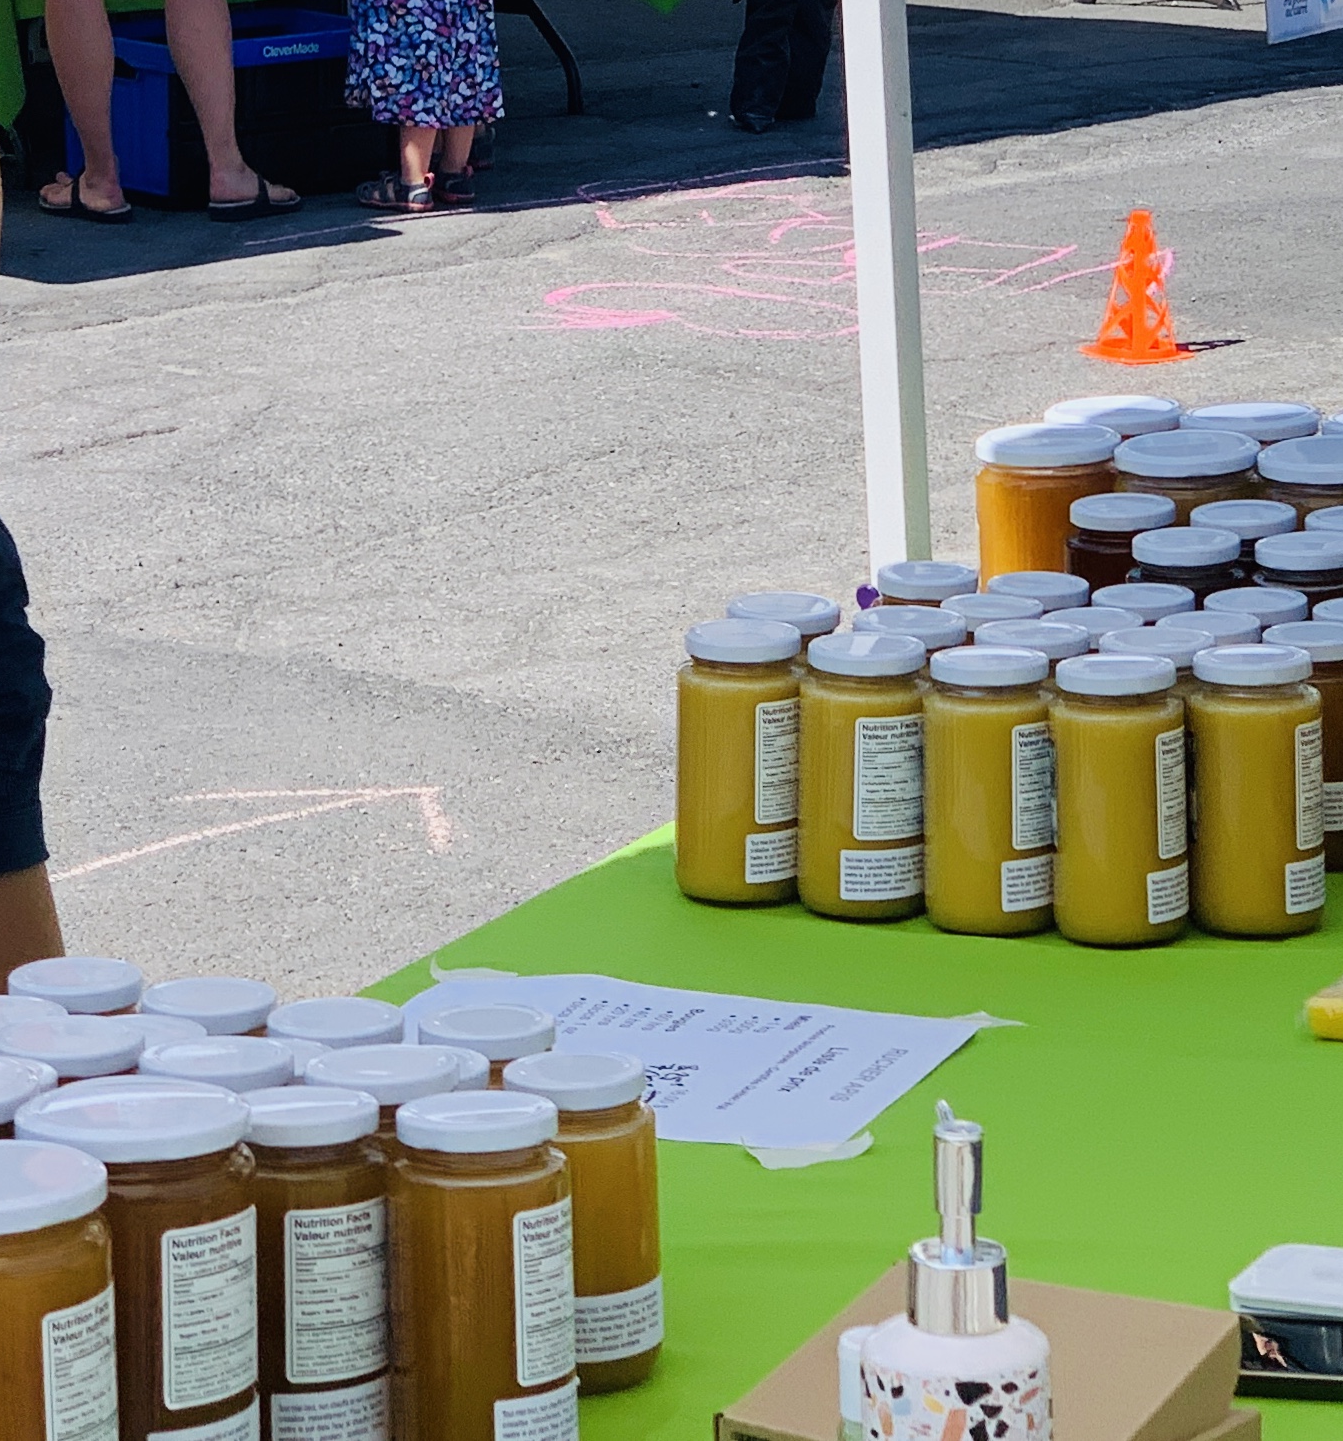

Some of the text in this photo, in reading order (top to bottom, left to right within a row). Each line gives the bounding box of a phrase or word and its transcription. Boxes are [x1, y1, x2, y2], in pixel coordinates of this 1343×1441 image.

[262, 43, 320, 58] CleverMade
[861, 722, 899, 732] Nutrition
[861, 730, 889, 741] Valeur
[853, 1047, 910, 1083] RUCHER
[294, 1211, 372, 1230] Nutrition Facts
[294, 1222, 373, 1242] Valeur nutritive
[172, 1232, 219, 1250] Nutrition
[172, 1247, 206, 1263] Valeur
